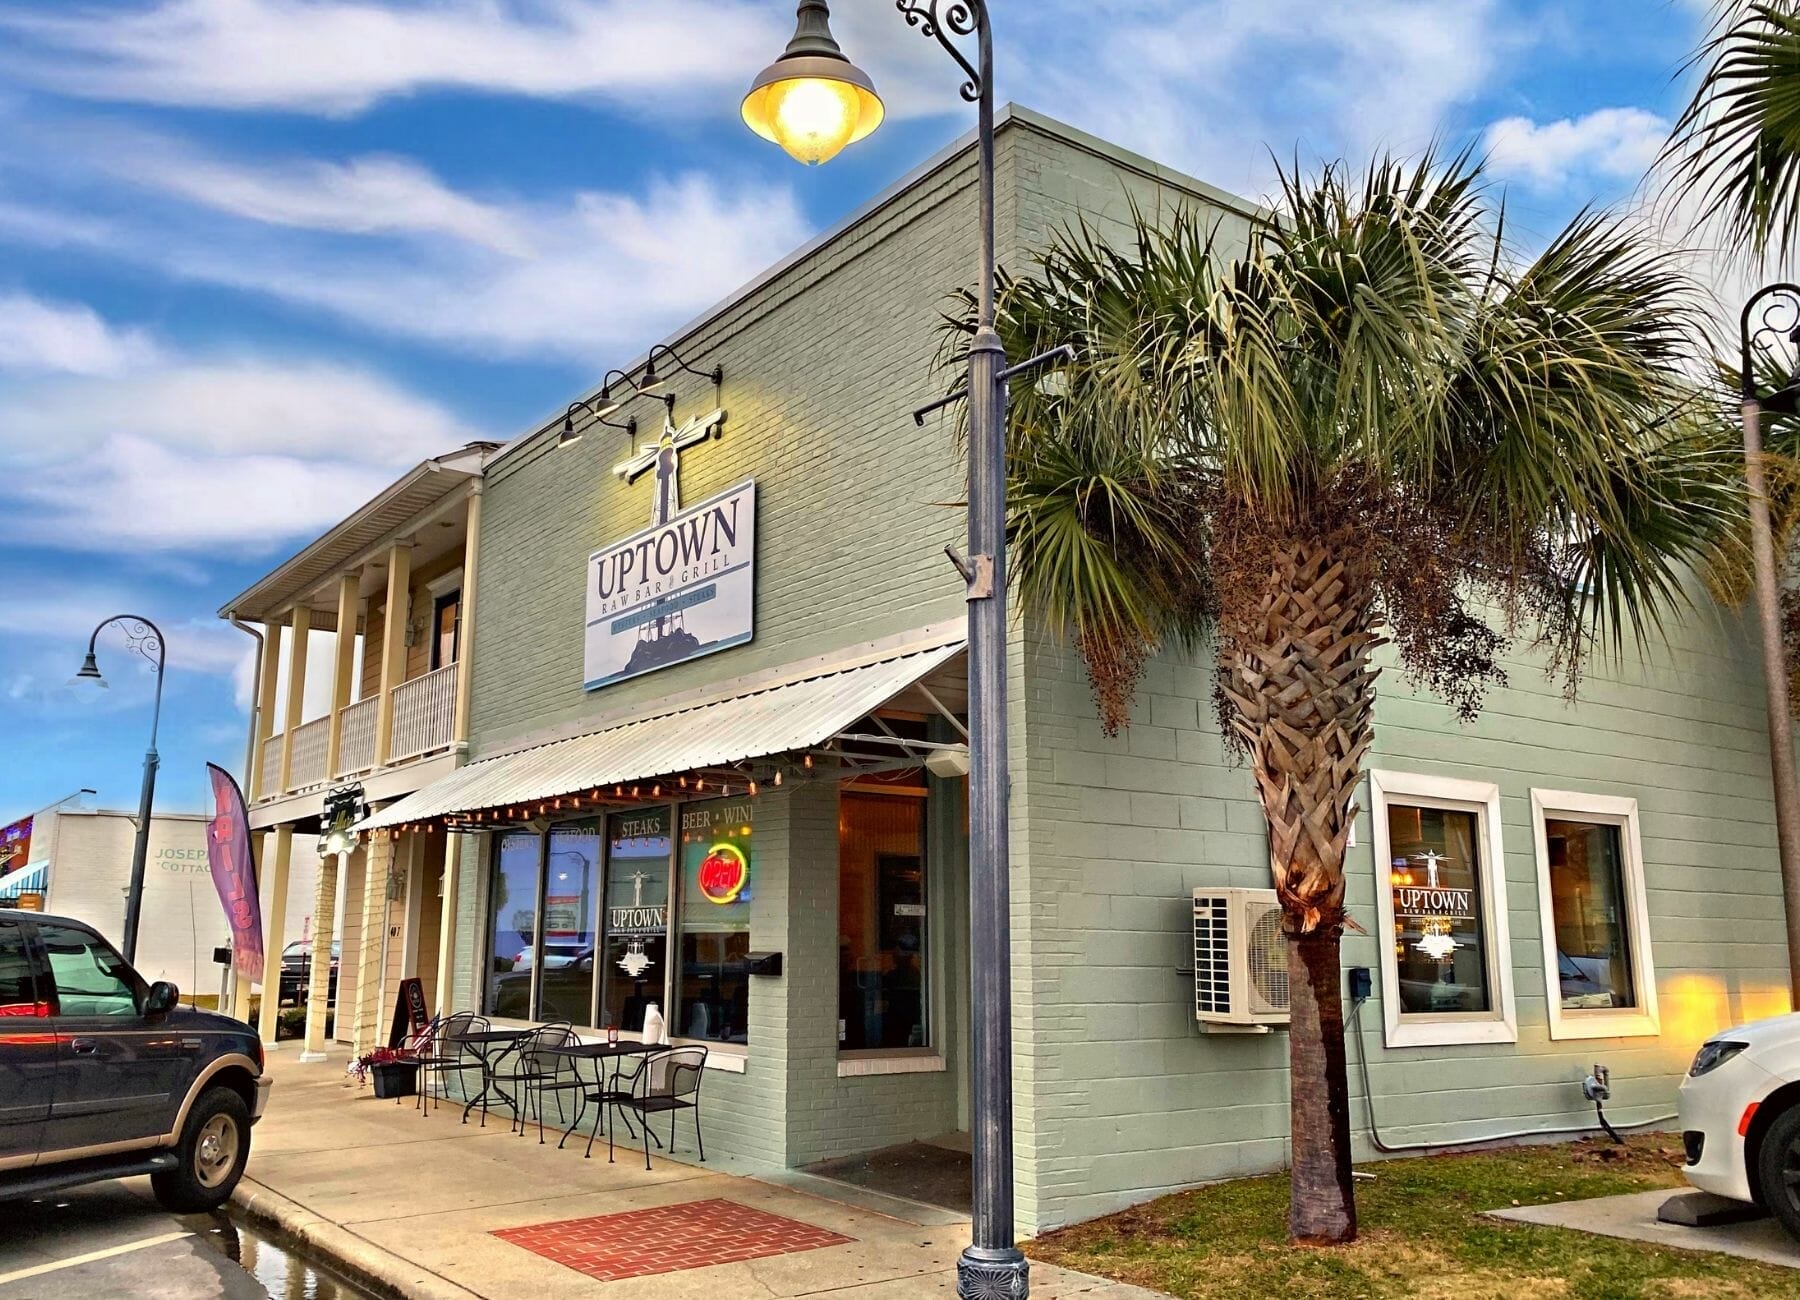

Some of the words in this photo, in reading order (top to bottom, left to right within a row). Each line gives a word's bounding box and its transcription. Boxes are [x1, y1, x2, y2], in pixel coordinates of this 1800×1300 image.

[597, 498, 740, 600] UPTOWN
[602, 594, 628, 615] RAW
[635, 581, 661, 602] BAR
[682, 554, 730, 583] GRILL
[622, 818, 660, 838] STEAKS
[682, 811, 711, 830] BEER
[155, 849, 208, 860] JOSEP
[702, 859, 741, 888] OPEN
[1399, 889, 1469, 911] UPTOWN
[612, 908, 663, 928] UPTOWN
